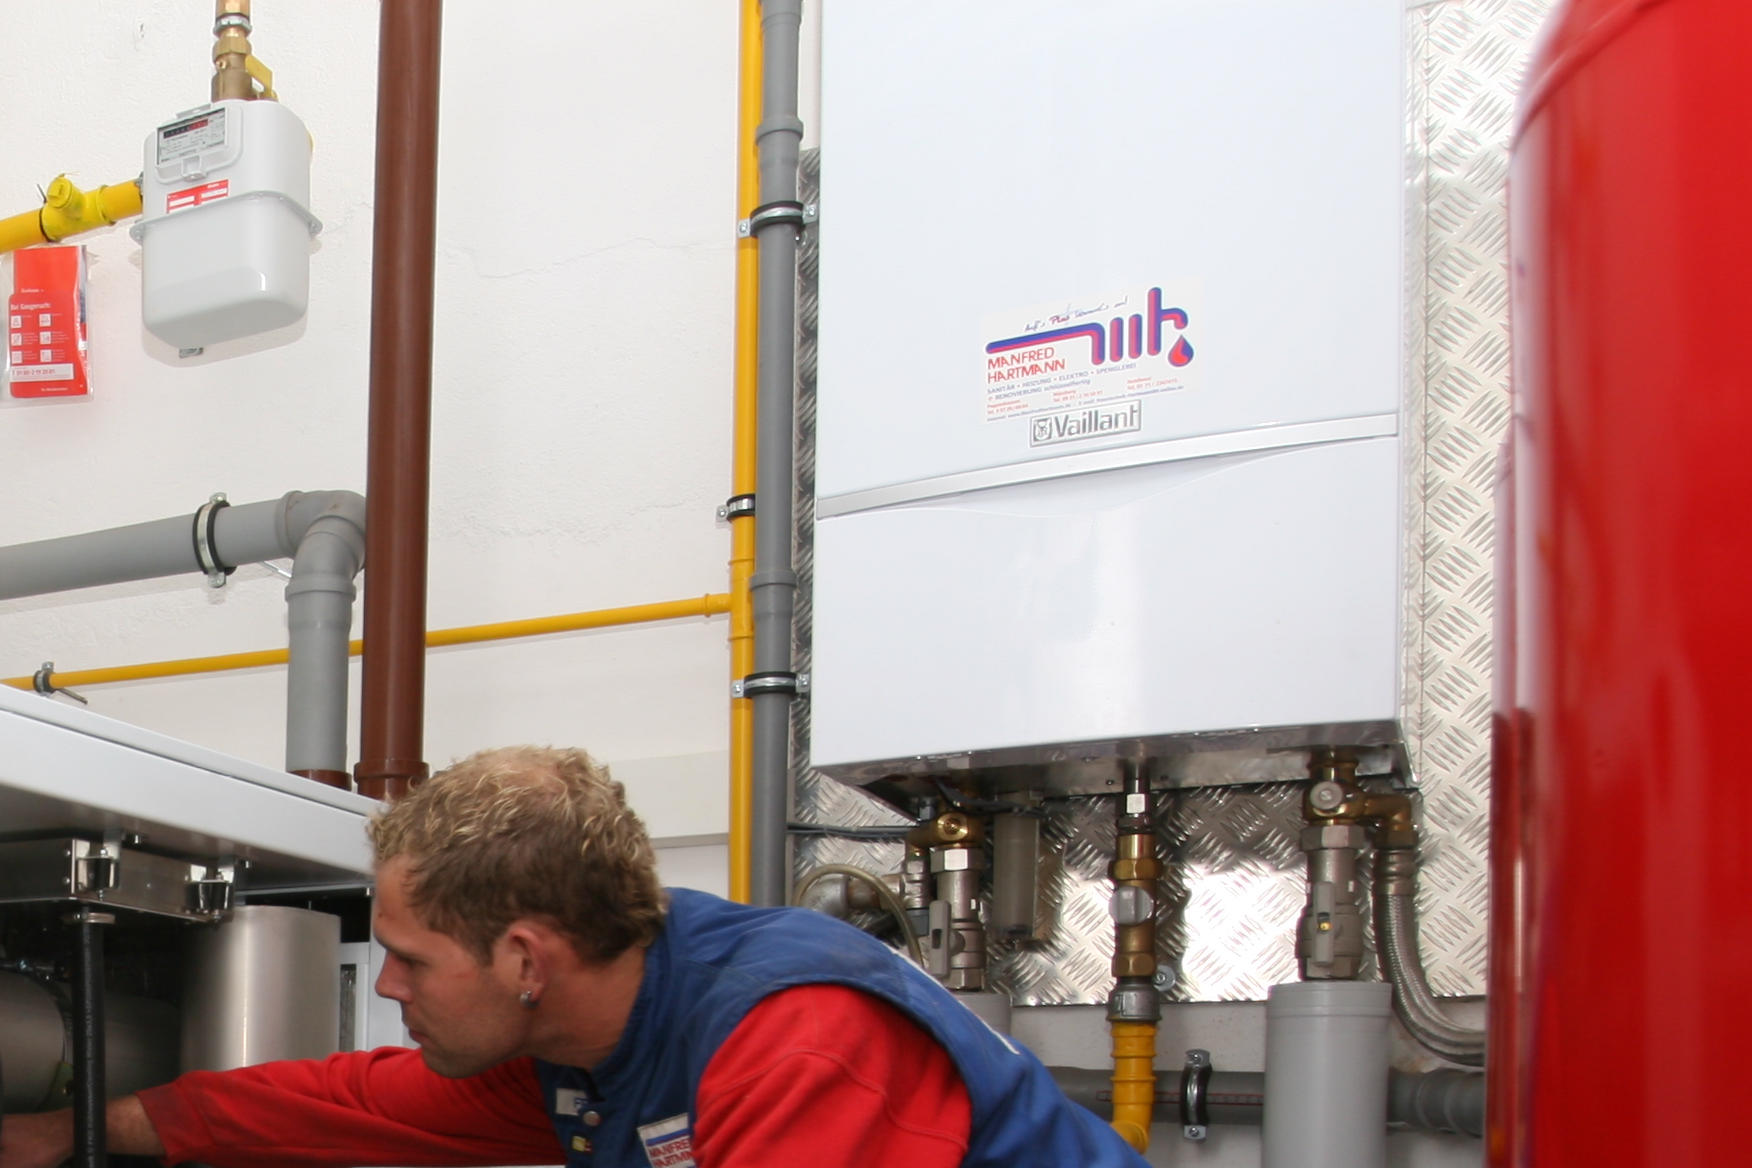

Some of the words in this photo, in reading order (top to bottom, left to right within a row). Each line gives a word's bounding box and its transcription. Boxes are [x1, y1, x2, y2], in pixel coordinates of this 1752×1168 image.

[987, 347, 1055, 371] MANFRED
[987, 358, 1066, 384] HARTMANN
[1054, 404, 1138, 438] Vaillant
[648, 1138, 691, 1158] MANFRE
